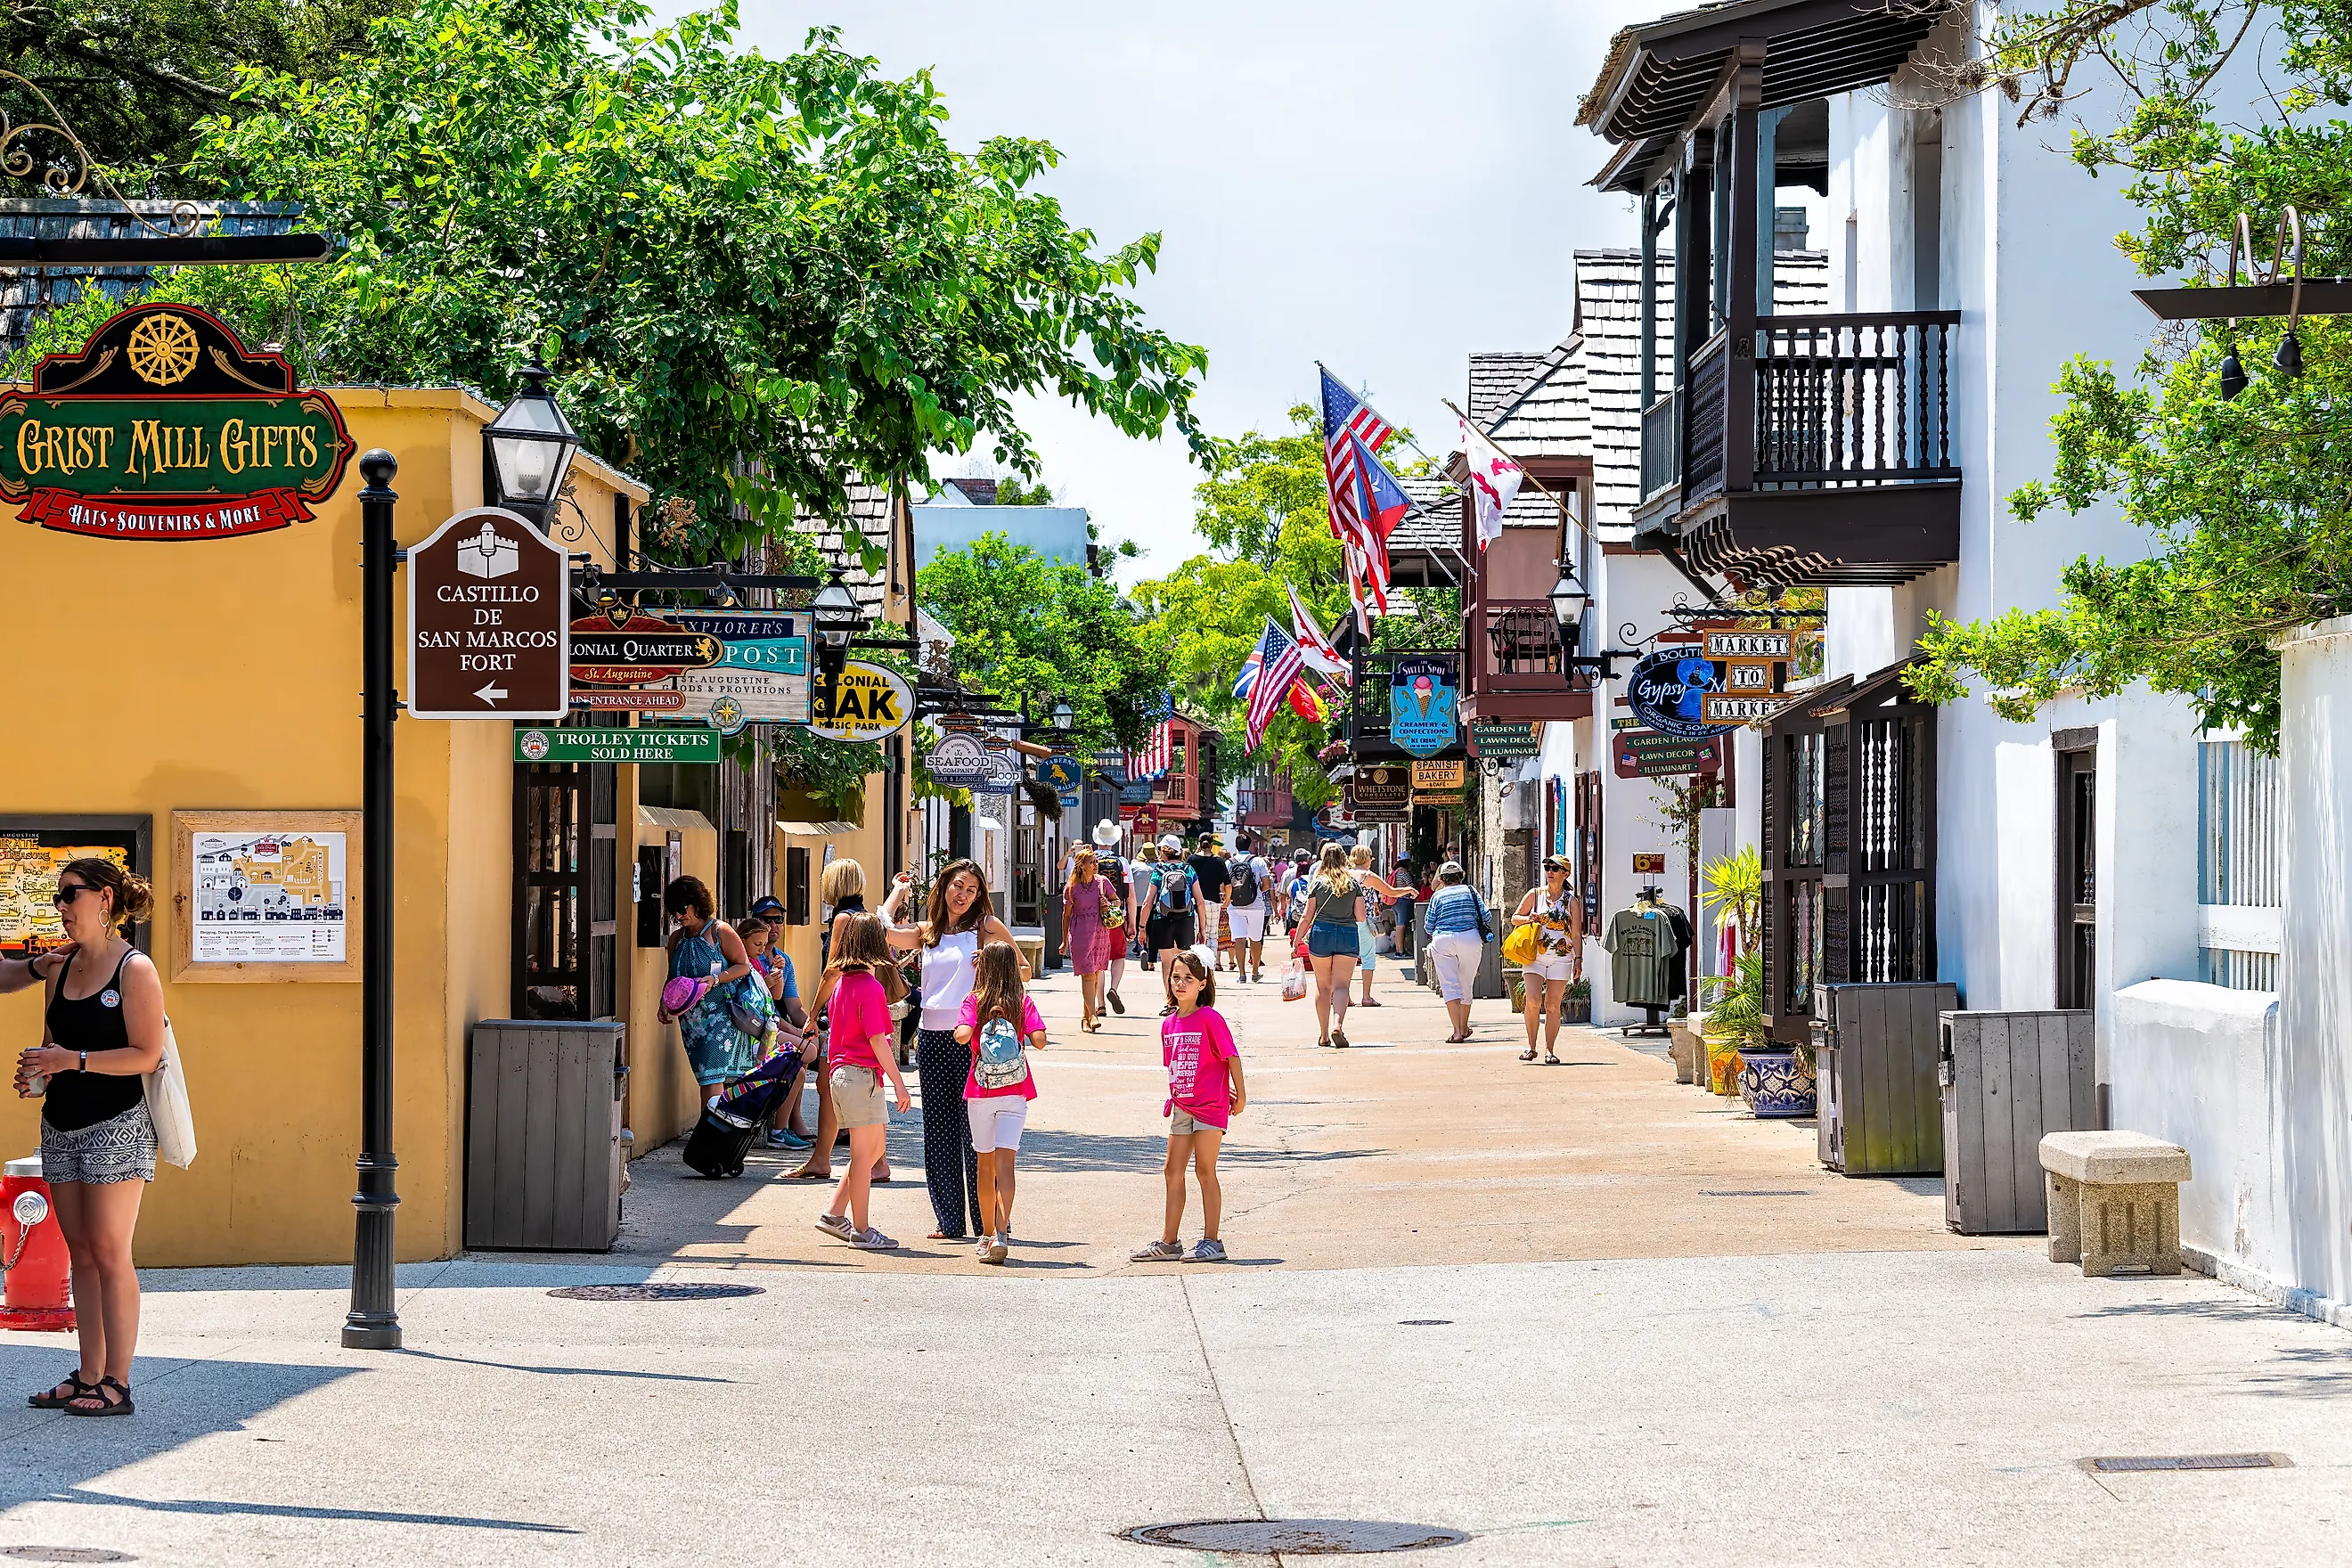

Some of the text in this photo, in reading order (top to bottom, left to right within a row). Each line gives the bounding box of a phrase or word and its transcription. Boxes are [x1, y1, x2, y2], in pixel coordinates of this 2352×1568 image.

[17, 419, 318, 484] GRIST MILL GIFTS
[205, 513, 215, 529] &
[219, 504, 262, 530] MORE
[437, 585, 540, 603] CASTILLO
[473, 608, 502, 625] DE
[682, 621, 783, 635] XPLORER'S
[418, 631, 558, 649] SAN MARCOS
[1713, 638, 1784, 653] MARKET
[623, 641, 694, 662] QUARTER
[723, 646, 801, 665] POST
[1658, 649, 1703, 661] BOUTI
[460, 654, 517, 672] FORT
[584, 668, 653, 682] St. Augustine
[681, 675, 771, 684] ST. AUGUSTINE
[1737, 670, 1760, 684] TO
[662, 684, 703, 693] GODS
[720, 686, 791, 694] PROVISIONS
[1637, 680, 1686, 705] Gypsy
[570, 696, 680, 706] AIN ENTRANCE AHEAD
[814, 688, 896, 721] AK
[1617, 719, 1639, 728] THE
[1644, 706, 1683, 730] ORGANIC
[854, 722, 882, 731] PARK
[1646, 715, 1665, 728] HAND
[1666, 727, 1687, 736] MADE
[556, 733, 635, 746] TROLLEY
[638, 733, 709, 747] TICKETS
[1633, 737, 1670, 746] GARDEN
[591, 747, 674, 759] SOLD HERE
[1642, 750, 1693, 761] LAWN DECOR
[927, 756, 990, 766] SEAFOOD
[1045, 757, 1076, 768] TABERNA
[1416, 761, 1458, 769] SPANISH
[1644, 764, 1692, 773] ILLUMINART
[1418, 771, 1457, 780] BAKERY
[1358, 785, 1406, 793] WHETSTONE
[0, 838, 39, 850] IRATE
[1184, 1035, 1201, 1043] GRADE
